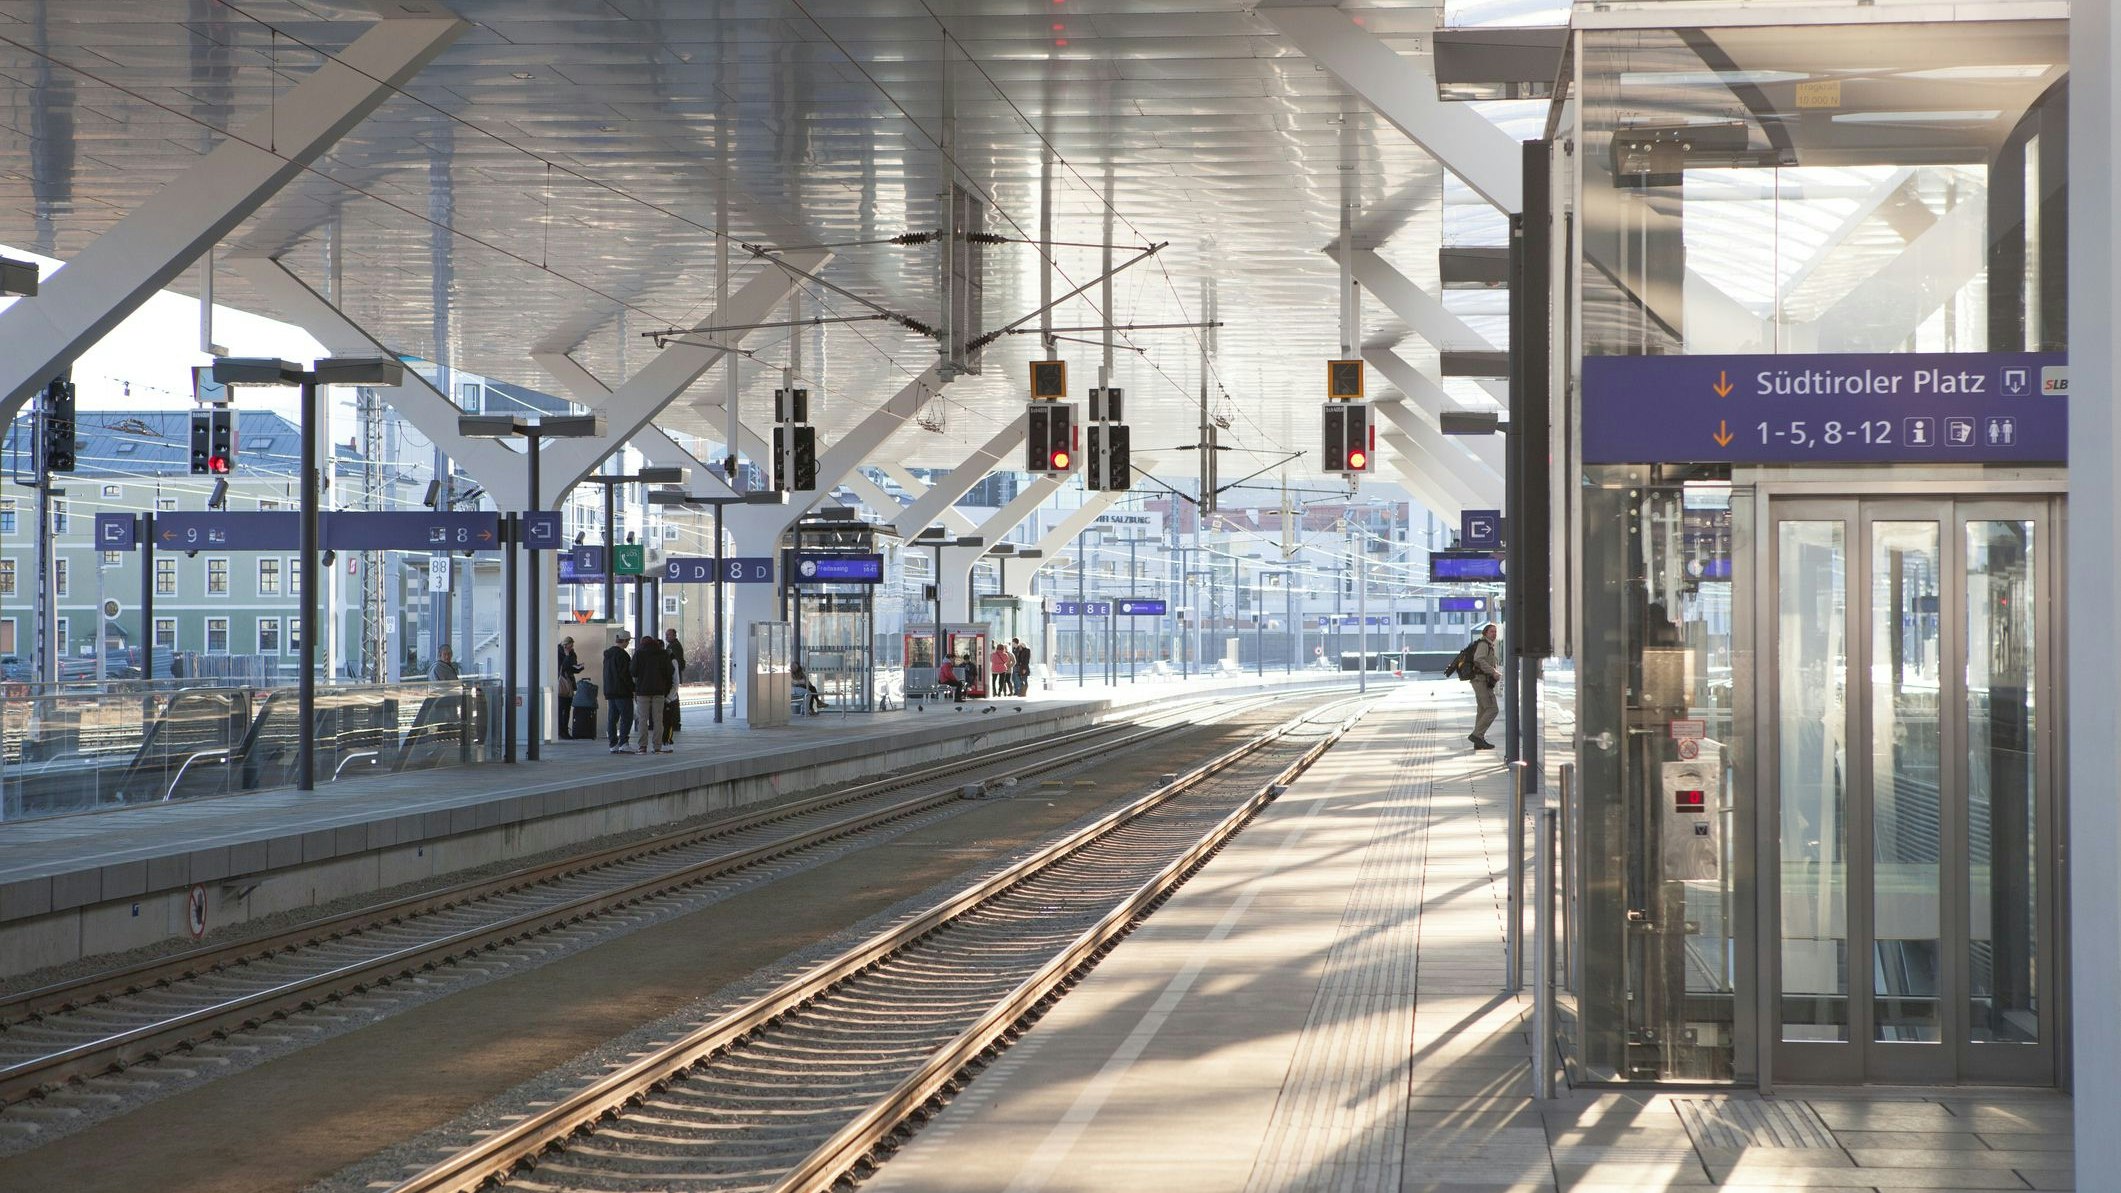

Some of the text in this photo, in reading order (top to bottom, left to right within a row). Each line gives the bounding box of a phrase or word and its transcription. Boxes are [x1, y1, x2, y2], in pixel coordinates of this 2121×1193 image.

[1756, 368, 1986, 395] Südtiroler Platz
[2044, 379, 2069, 390] SLB
[187, 528, 197, 543] 9
[457, 528, 468, 542] 8
[432, 560, 447, 573] 88
[669, 563, 705, 579] 9 D
[730, 562, 767, 579] 8 D
[436, 576, 443, 588] 3
[1069, 606, 1075, 614] E
[1087, 604, 1107, 614] 8 E
